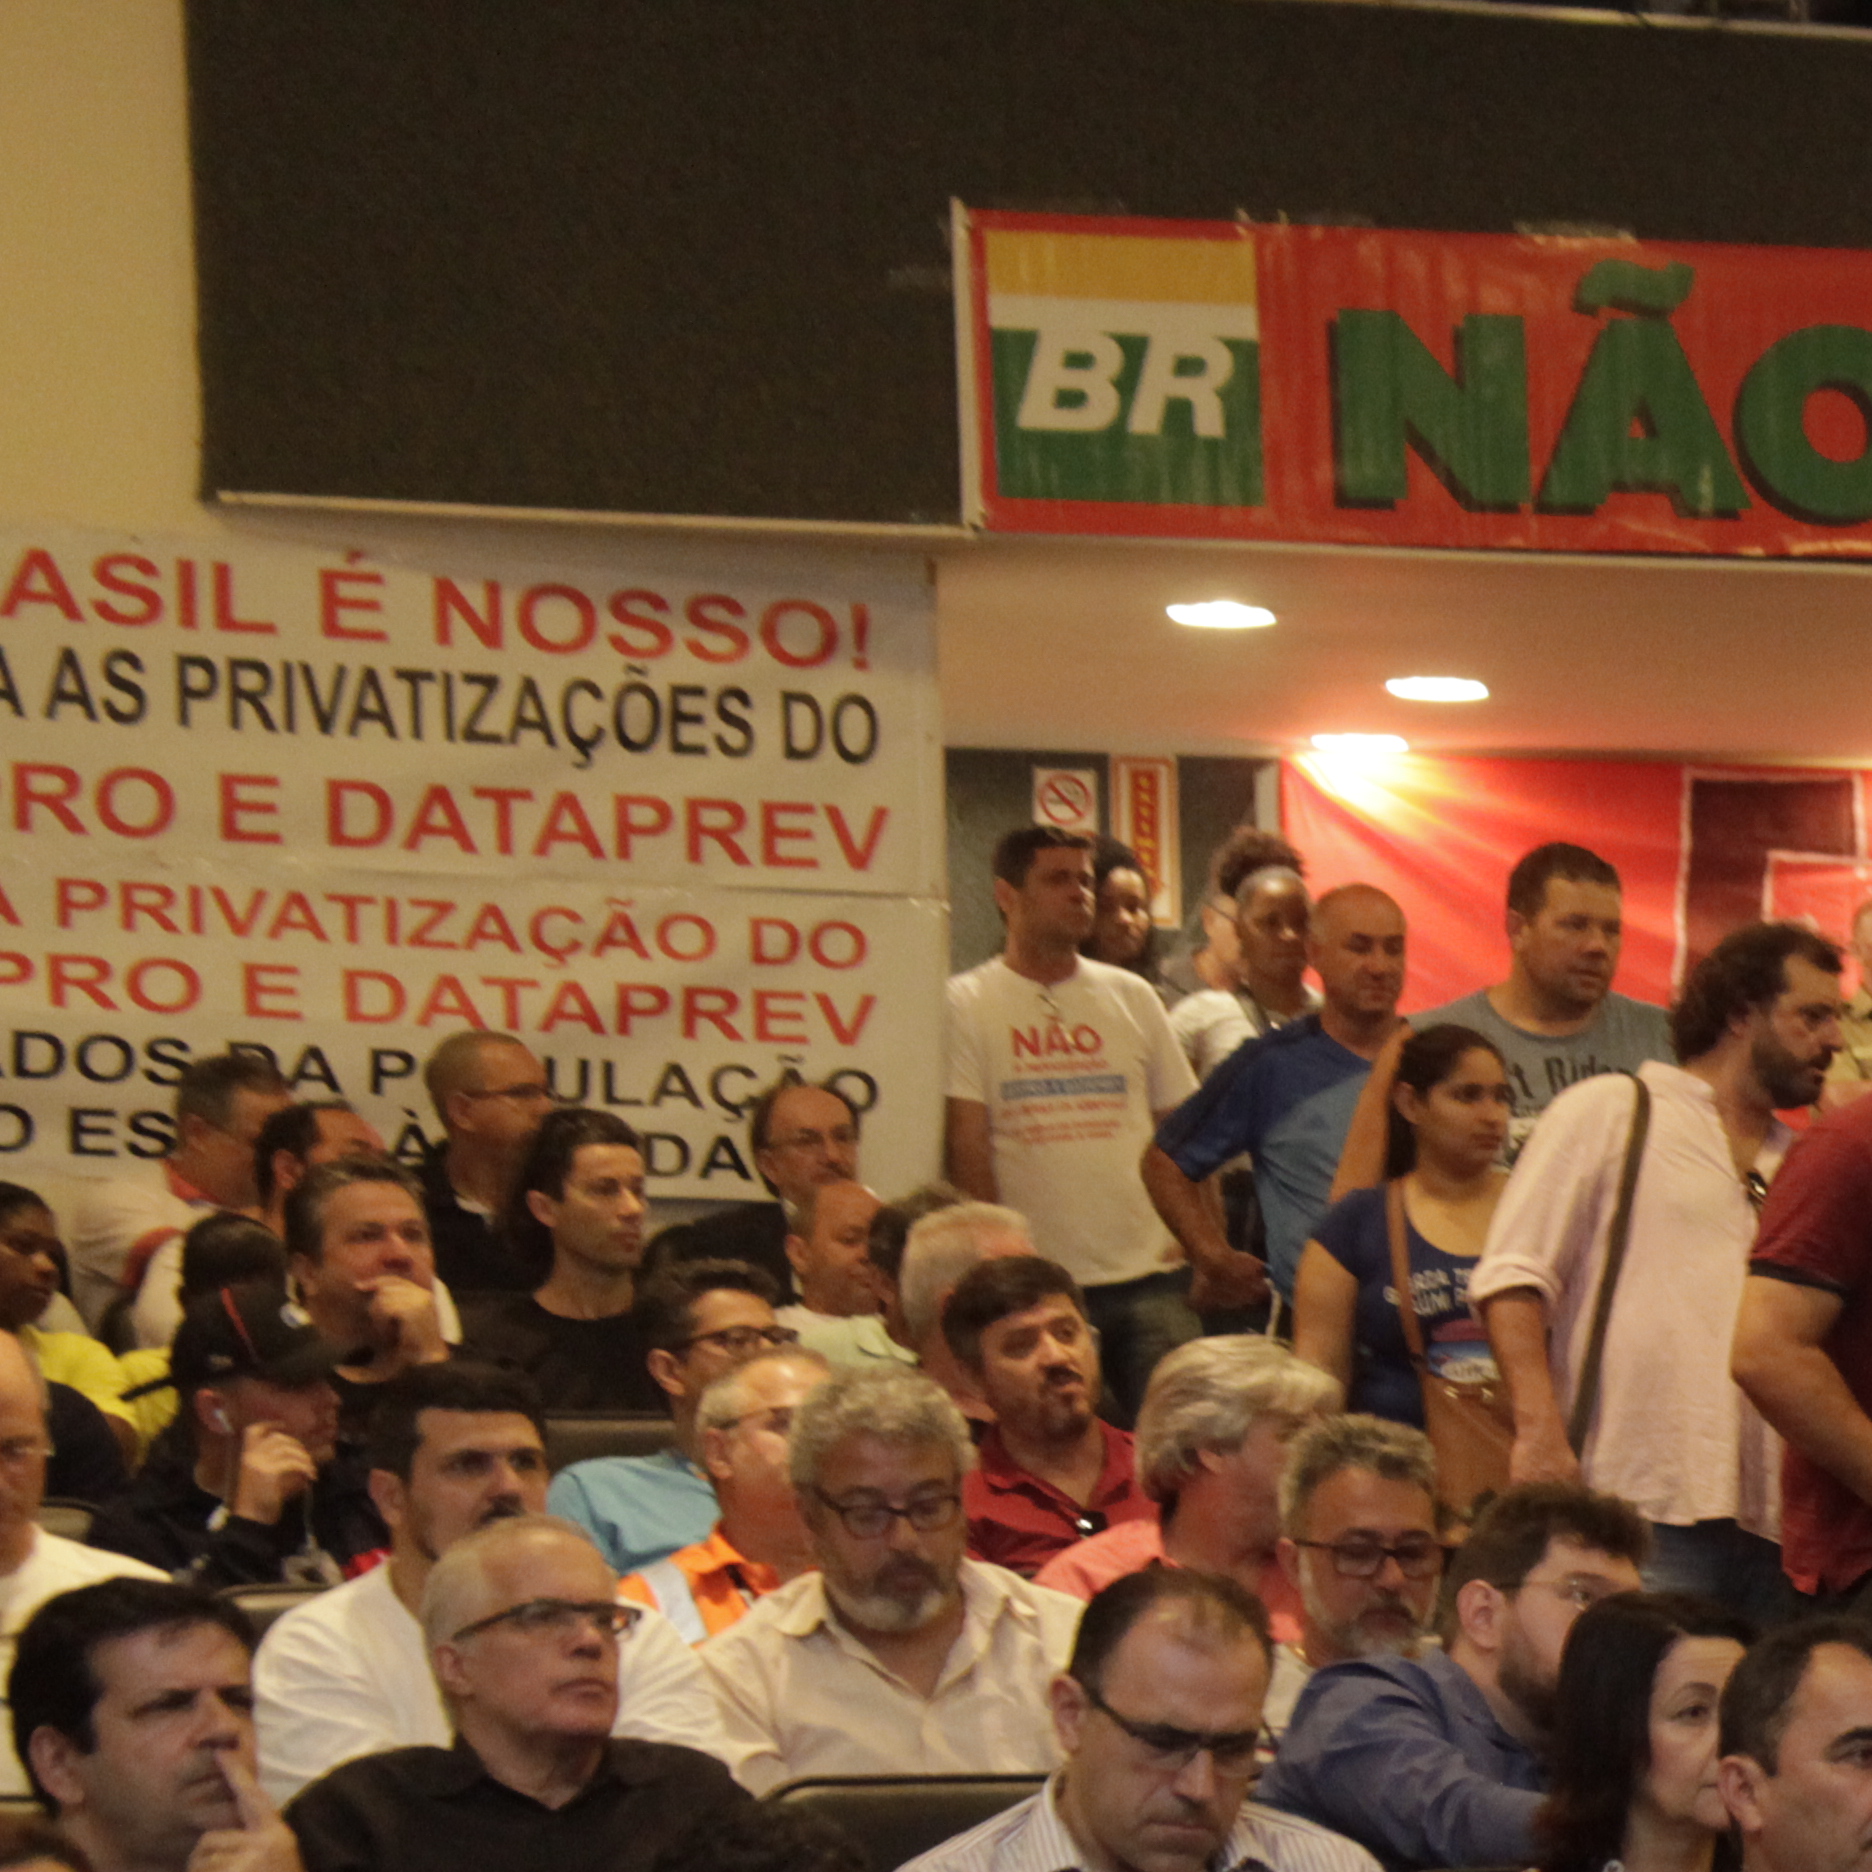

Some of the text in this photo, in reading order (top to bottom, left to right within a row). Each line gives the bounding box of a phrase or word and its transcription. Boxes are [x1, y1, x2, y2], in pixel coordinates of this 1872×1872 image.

[1016, 331, 1233, 439] BR
[319, 548, 390, 643] É
[434, 576, 871, 671] NOSSO!
[45, 646, 148, 725] AS
[175, 653, 754, 769] PRIVATIZAÇÕES
[781, 690, 879, 765] DO
[219, 773, 284, 846] E
[326, 778, 890, 871] DATAPREV
[55, 877, 718, 968] PRIVATIZAÇÃO
[750, 917, 868, 970] DO
[243, 962, 303, 1021] E
[343, 968, 876, 1046] DATAPREV
[1011, 1013, 1105, 1058] NÃO
[0, 1030, 194, 1087] DOS
